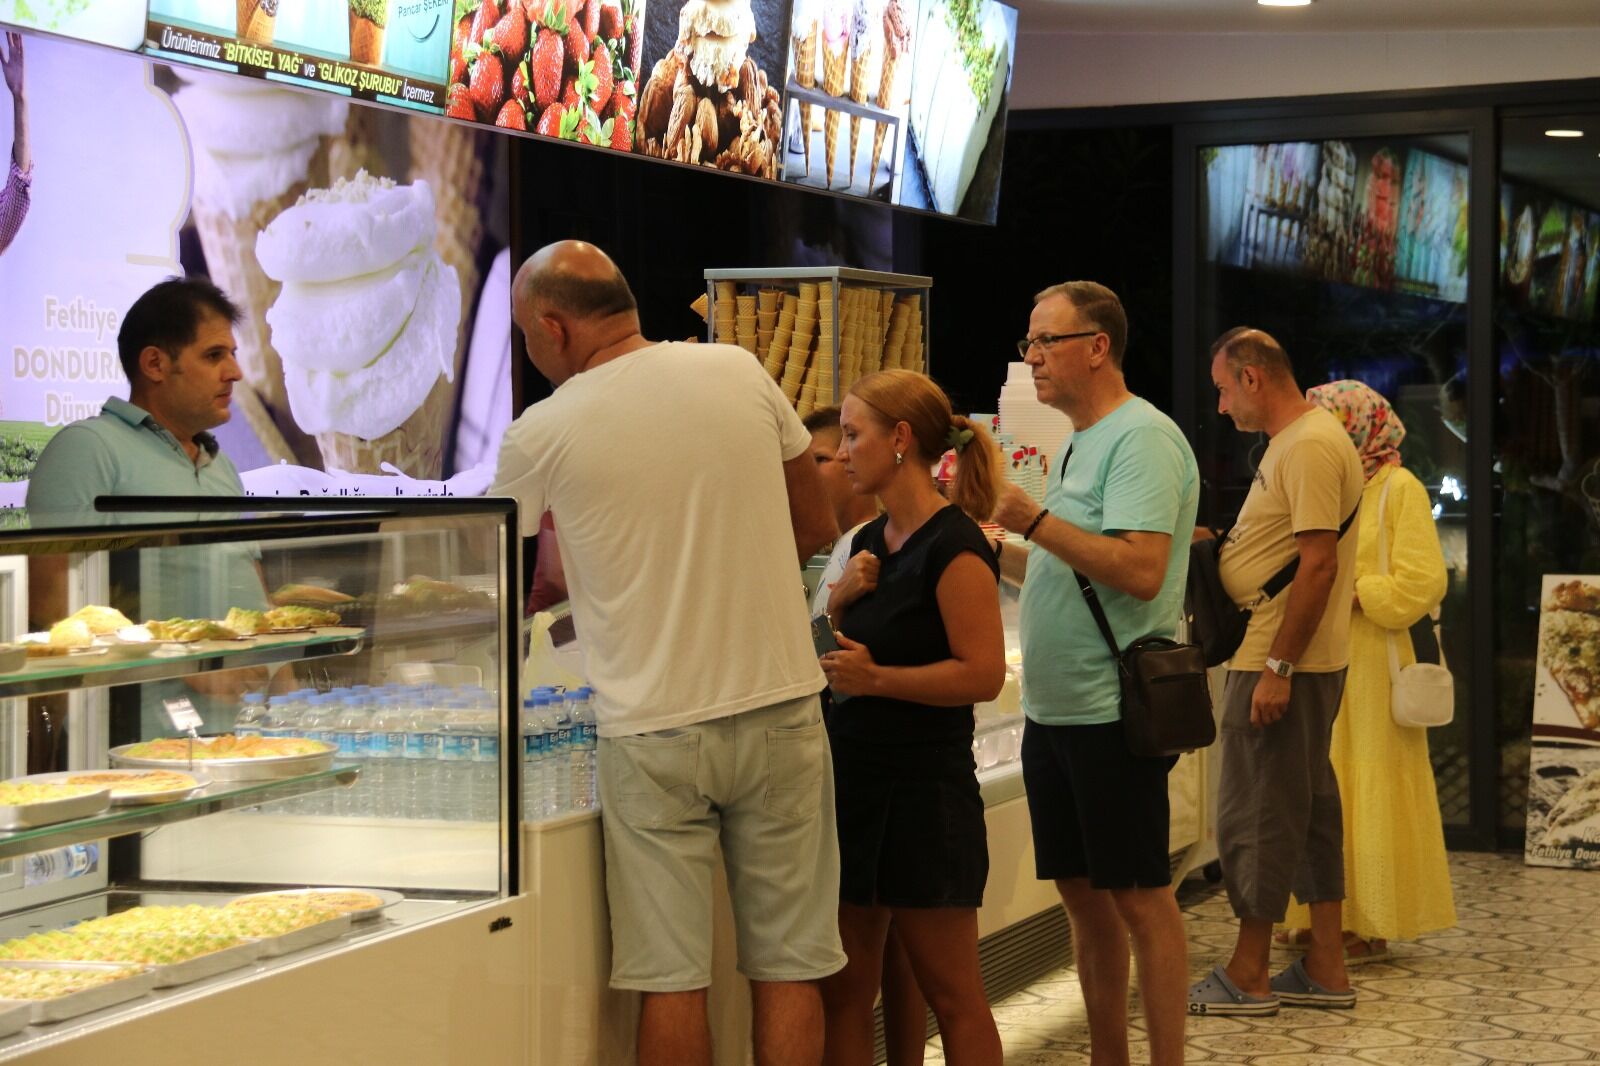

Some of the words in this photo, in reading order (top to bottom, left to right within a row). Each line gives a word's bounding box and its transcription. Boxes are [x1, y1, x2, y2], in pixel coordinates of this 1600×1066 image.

[162, 26, 221, 59] Ürünlerimiz
[304, 62, 316, 78] ve
[402, 78, 435, 103] İçermez
[45, 298, 118, 341] Fethiye
